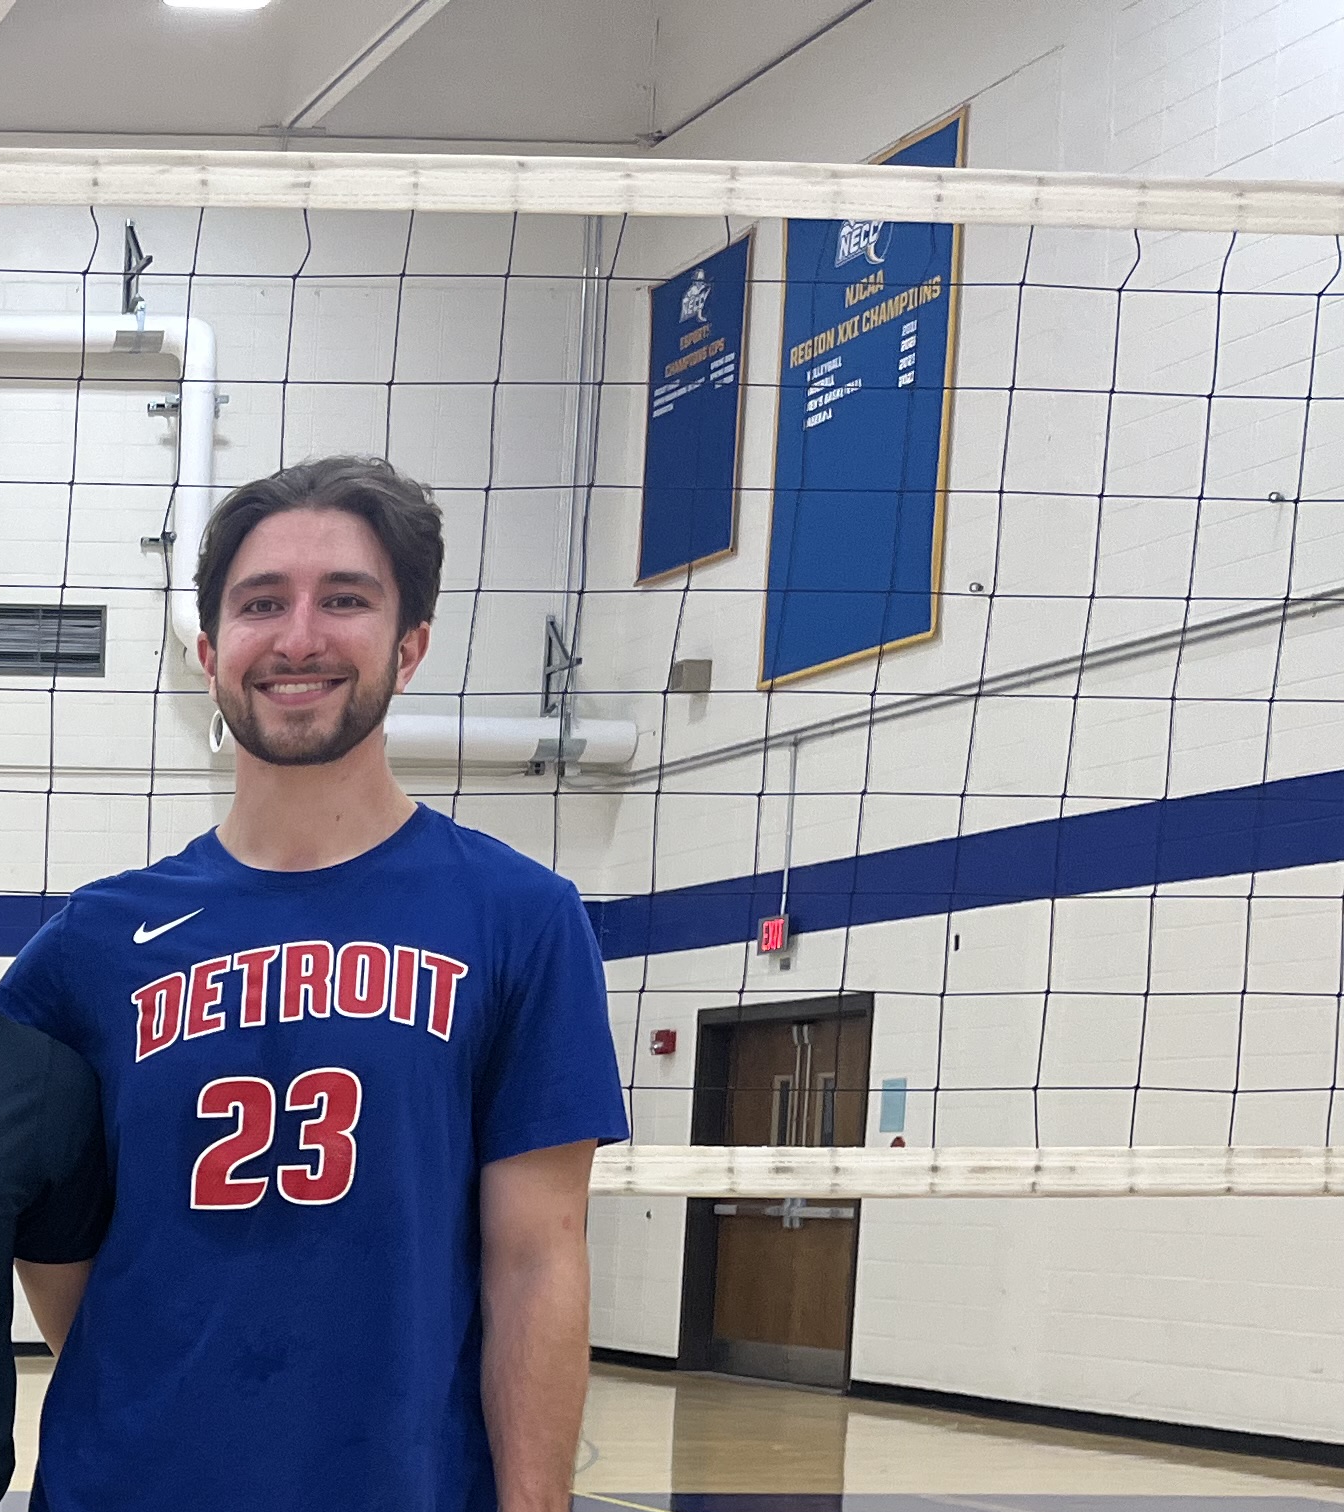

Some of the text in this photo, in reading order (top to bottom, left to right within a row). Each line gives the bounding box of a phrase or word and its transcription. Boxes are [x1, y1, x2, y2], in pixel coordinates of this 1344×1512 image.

[839, 220, 883, 258] NECC
[844, 269, 885, 308] NJCAA
[790, 327, 835, 368] REGION
[836, 314, 860, 346] XXI
[761, 918, 785, 951] EXIT
[130, 939, 469, 1063] DETROIT
[190, 1066, 363, 1209] 23
